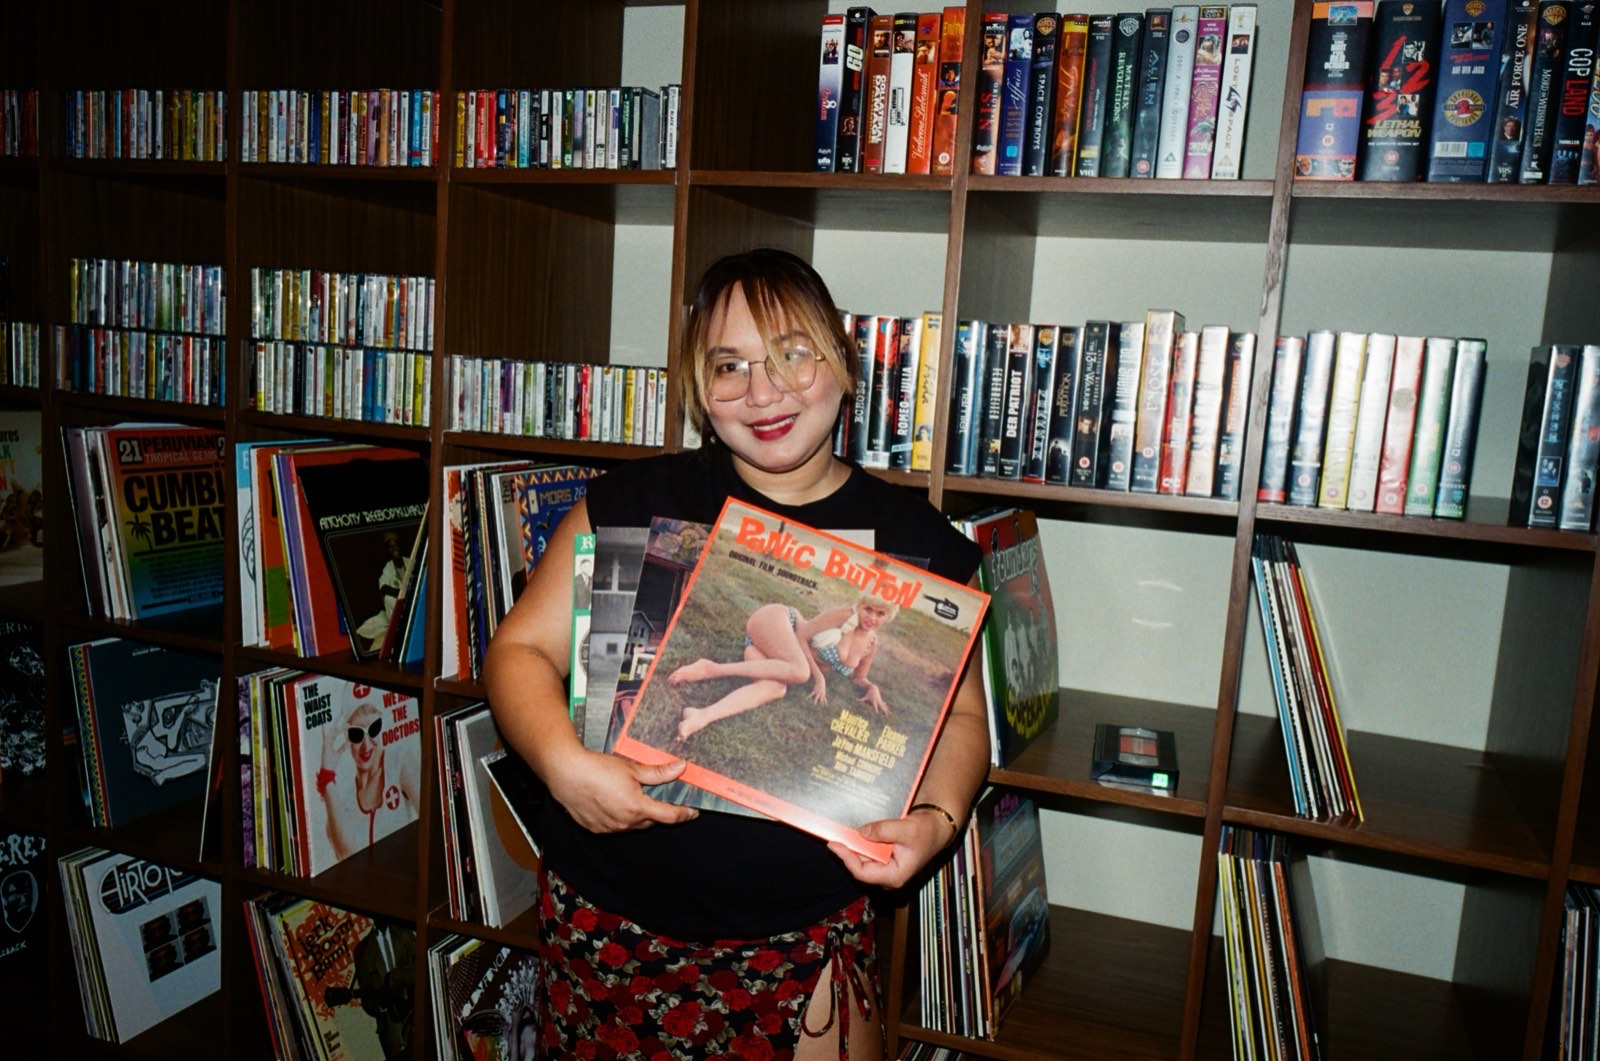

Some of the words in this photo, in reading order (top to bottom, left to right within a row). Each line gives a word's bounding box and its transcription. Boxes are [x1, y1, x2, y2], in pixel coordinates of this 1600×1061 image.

[1516, 23, 1528, 47] ONE
[847, 44, 863, 72] 60
[1381, 34, 1407, 71] 1
[1569, 48, 1594, 77] COP
[1145, 50, 1159, 105] ALIEN
[1233, 58, 1241, 90] LOST
[1400, 60, 1430, 94] 2
[1512, 50, 1524, 86] FORCE
[1541, 69, 1552, 92] MORD
[1006, 68, 1026, 110] Affairs
[1036, 74, 1046, 102] SPACE
[1112, 52, 1126, 122] REVOLUTIONS
[1122, 64, 1133, 109] MATRIX
[1509, 88, 1520, 109] AIR
[1562, 79, 1589, 116] LAND
[871, 75, 882, 144] DAMAGE
[878, 74, 887, 142] COLLATERAL
[979, 92, 993, 130] SIN
[1366, 91, 1399, 124] 3
[1456, 98, 1474, 115] 2
[1537, 97, 1549, 126] WEISSEN
[912, 119, 926, 159] Verlorene
[1033, 106, 1044, 150] COWBOYS
[1224, 112, 1234, 150] SPACE
[1367, 129, 1421, 138] WEAPON
[1374, 120, 1421, 129] LETHAL
[901, 366, 913, 394] JULIA
[1007, 370, 1022, 414] PATRIOT
[1082, 371, 1095, 411] WARRIOR
[854, 381, 866, 423] ECHOES
[897, 401, 909, 436] ROMEO
[1006, 415, 1017, 438] DER
[118, 439, 143, 463] 21
[144, 435, 217, 454] PERUVIAN
[145, 452, 191, 464] TROPICAL
[192, 451, 218, 461] GEMS
[503, 480, 512, 504] the
[538, 488, 572, 506] MORIS
[151, 506, 225, 547] BEAT
[319, 512, 361, 531] ANTHONY
[728, 550, 757, 568] ORIGINAL
[758, 562, 774, 573] FILM
[302, 683, 319, 700] THE
[304, 694, 331, 715] WAIST
[306, 709, 333, 730] COATS
[392, 705, 408, 723] THE
[382, 718, 420, 747] DOCTORS
[830, 719, 871, 743] CHEVALIER
[853, 743, 896, 769] MANSFIELD
[876, 736, 907, 758] PARKER
